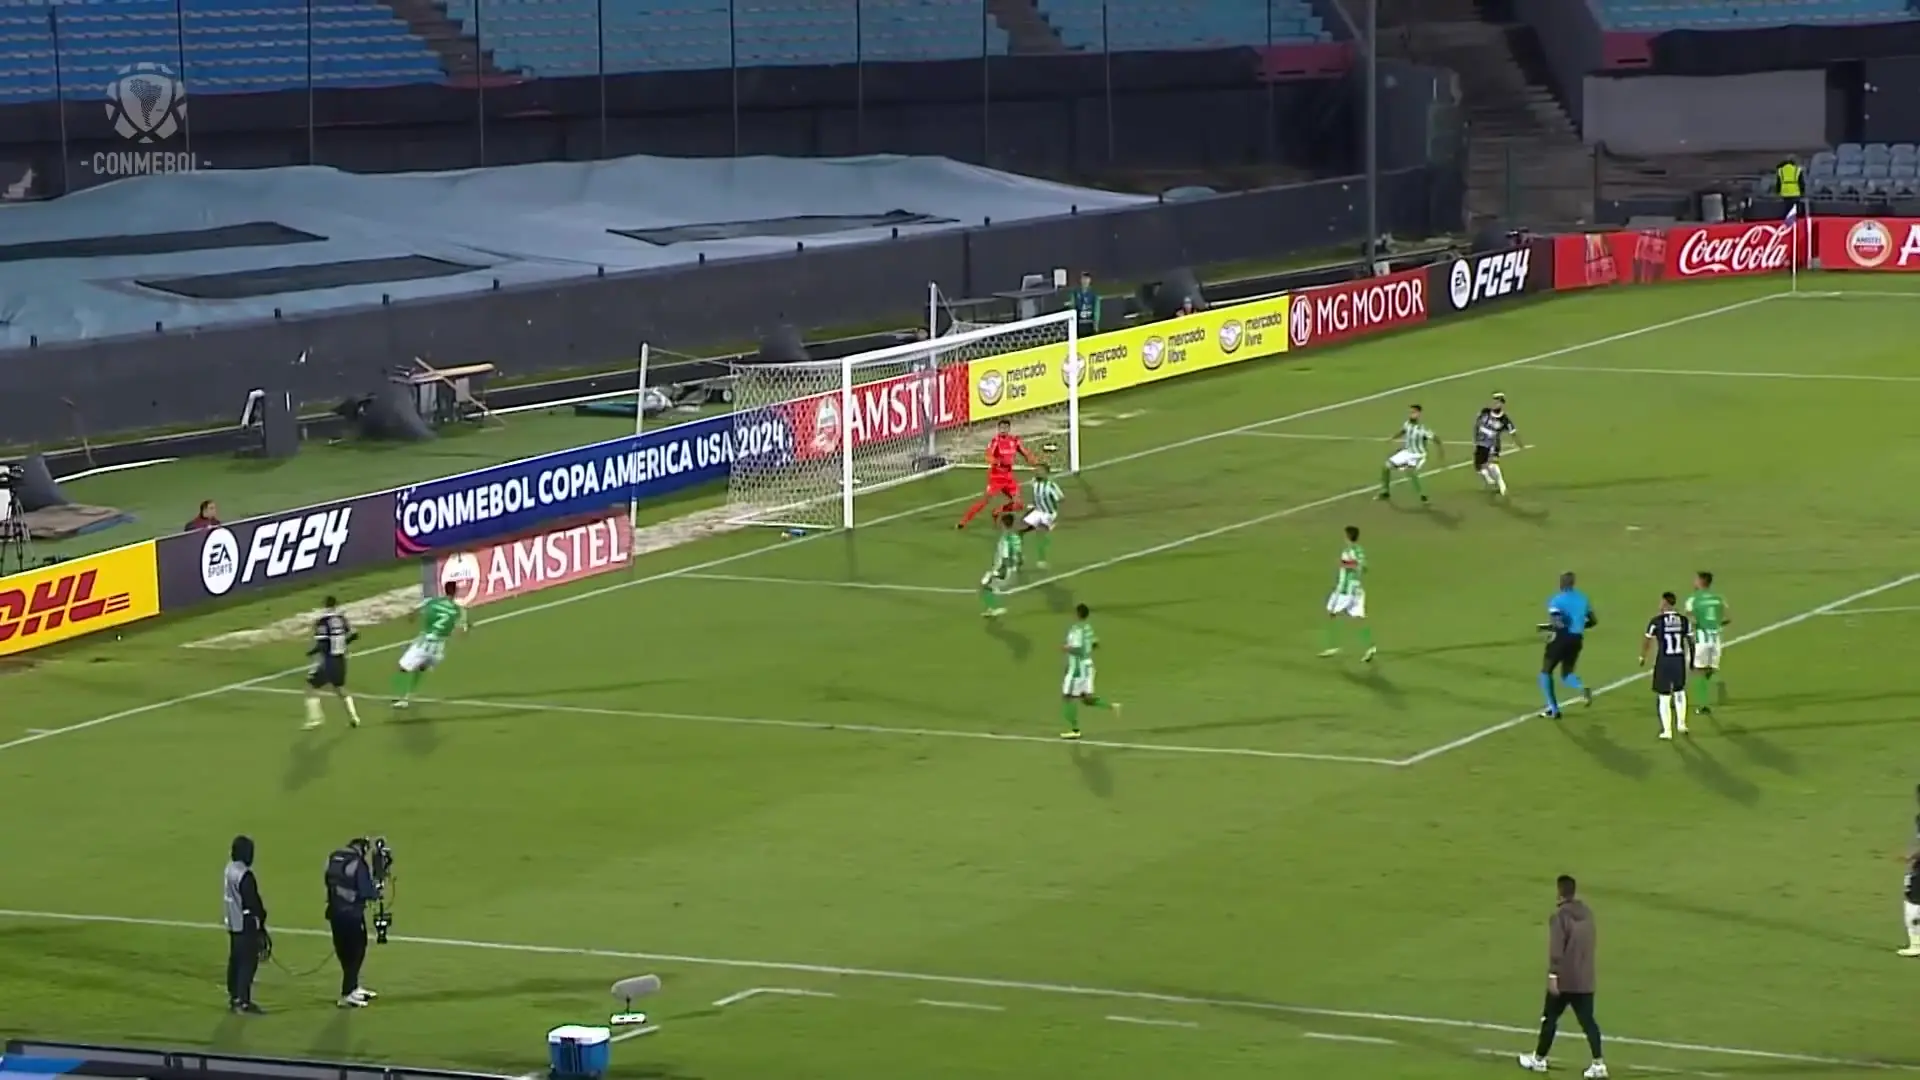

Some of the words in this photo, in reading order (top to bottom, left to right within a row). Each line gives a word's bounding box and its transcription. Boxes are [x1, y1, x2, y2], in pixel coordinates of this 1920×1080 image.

[1680, 225, 1792, 274] Coca-Cola
[1316, 293, 1349, 336] MG
[1352, 278, 1425, 329] MOTOR
[1245, 312, 1282, 331] mercado
[1168, 326, 1206, 347] mercado
[1088, 344, 1128, 365] mercado
[1006, 360, 1047, 382] mercado
[1088, 366, 1107, 382] livre
[1006, 383, 1027, 399] libre
[403, 476, 535, 537] CONMEBOL
[538, 461, 600, 505] COPA
[602, 439, 694, 491] AMERICA
[696, 430, 735, 469] USA
[737, 419, 784, 458] 2024
[208, 543, 232, 566] EA
[485, 517, 629, 596] AMSTEL
[207, 563, 233, 579] SPORTS
[0, 568, 106, 641] DHL
[1664, 632, 1683, 655] 11
